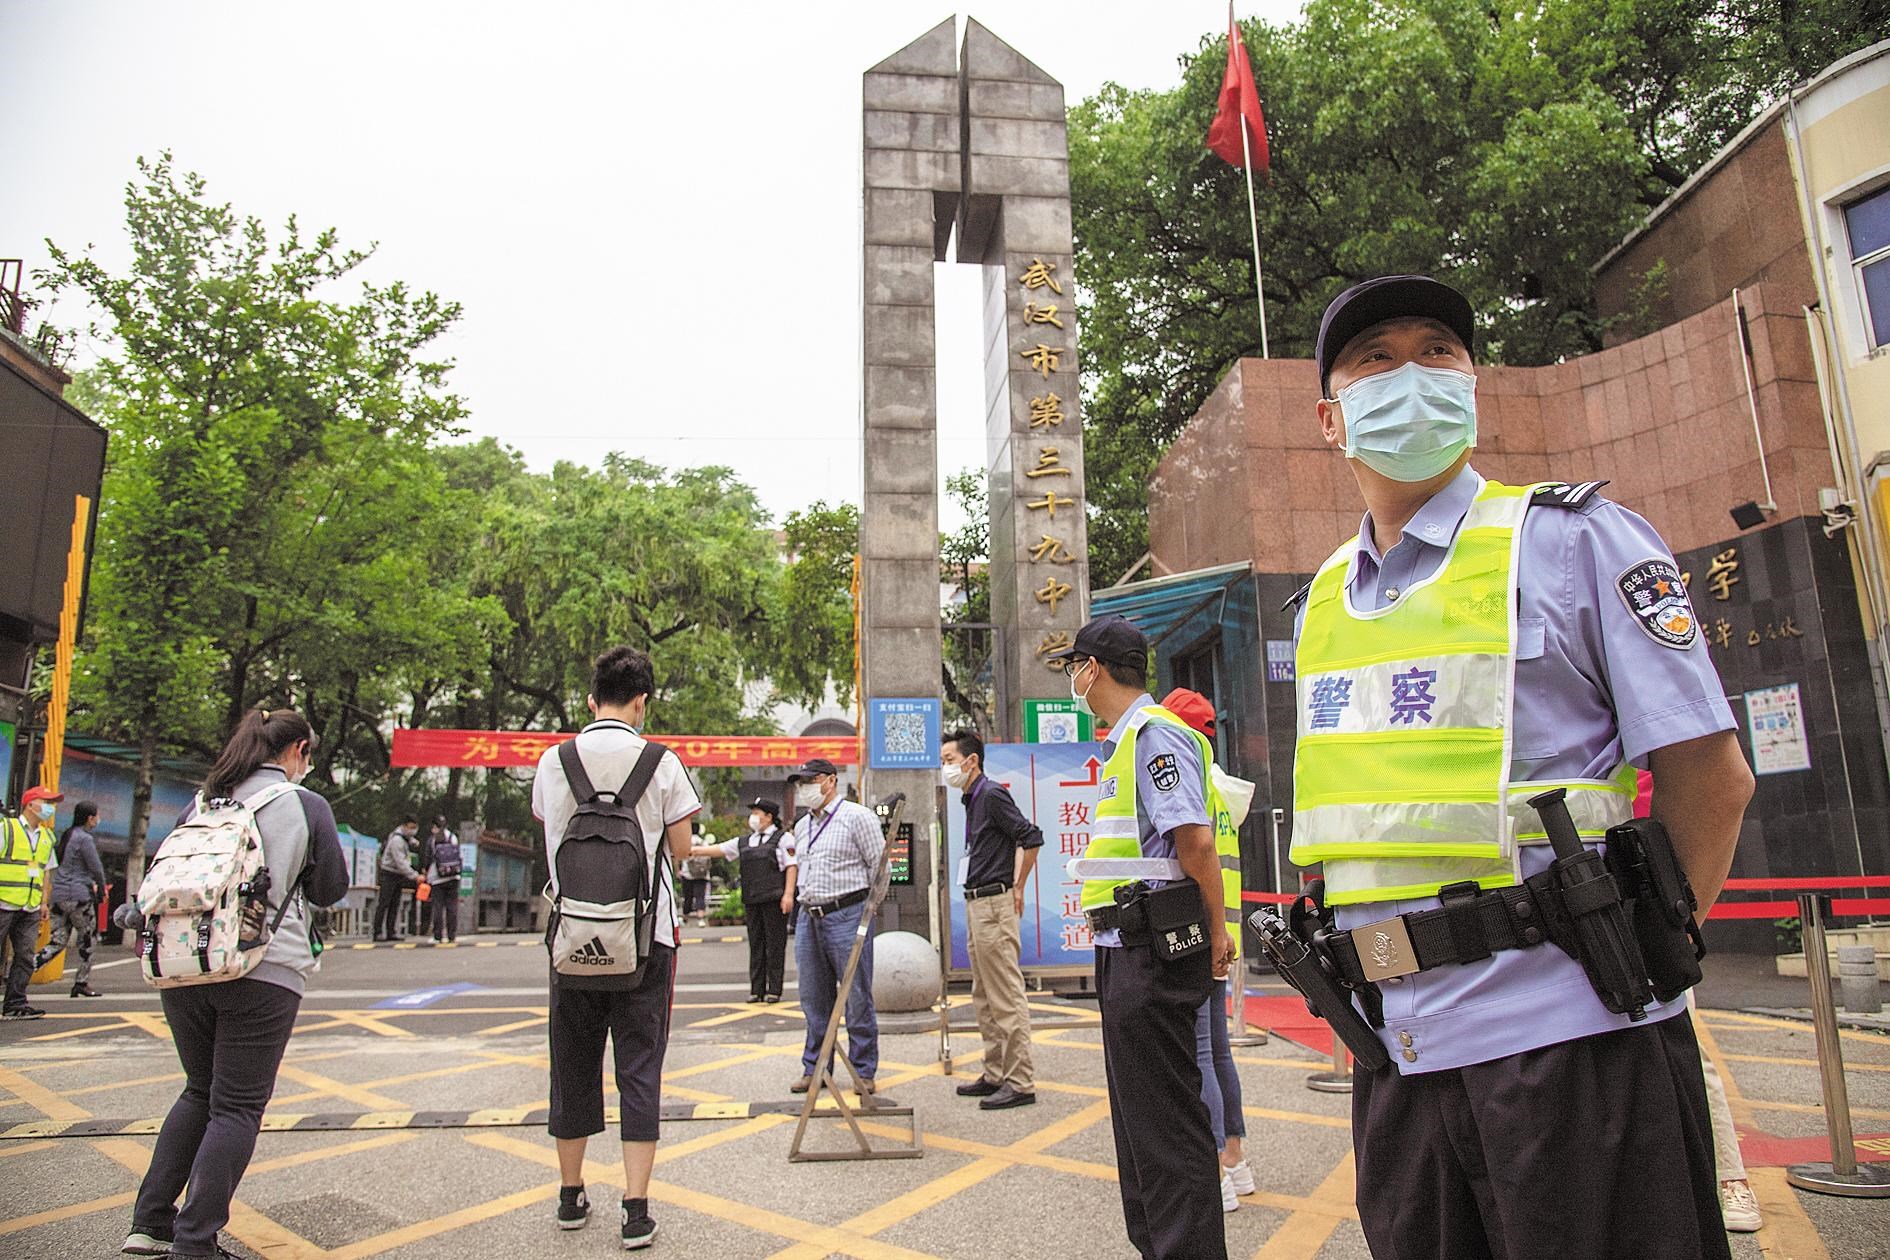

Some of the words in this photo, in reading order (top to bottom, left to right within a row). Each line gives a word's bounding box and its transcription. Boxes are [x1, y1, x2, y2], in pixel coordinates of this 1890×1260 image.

[1019, 257, 1076, 673] 武汉市第三十九中学
[1308, 666, 1437, 730] 警察
[1058, 801, 1093, 950] 教职通道
[1165, 923, 1201, 945] 警察
[1169, 934, 1204, 954] POLICE
[569, 954, 615, 966] adidas
